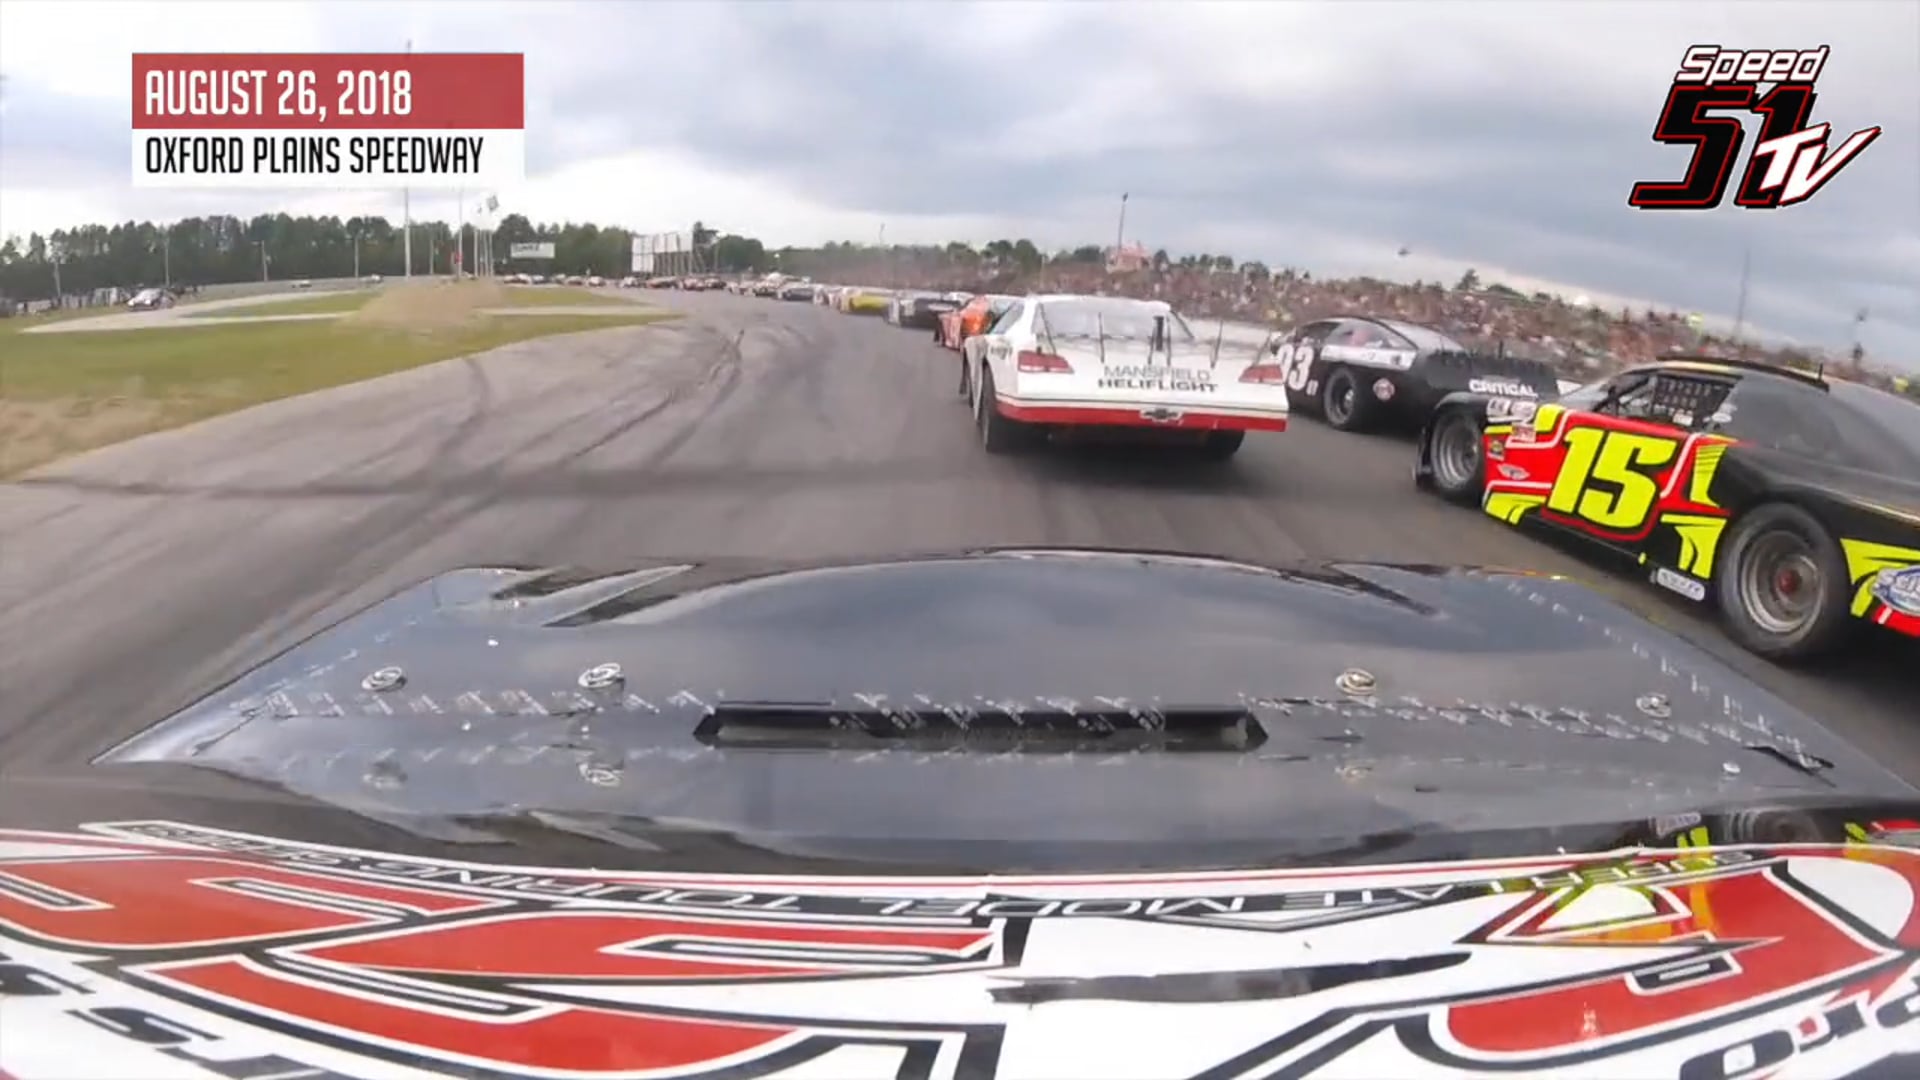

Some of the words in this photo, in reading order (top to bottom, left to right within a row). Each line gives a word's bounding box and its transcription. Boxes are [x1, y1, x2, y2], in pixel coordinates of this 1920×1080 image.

[1103, 365, 1211, 381] MANSFIELD
[1097, 379, 1218, 392] HELIFLIGHT
[1468, 379, 1538, 398] CRITICAL
[1547, 427, 1677, 528] 15
[360, 862, 800, 911] TOURING
[1283, 880, 1504, 909] LATE
[861, 896, 1244, 915] MODEL
